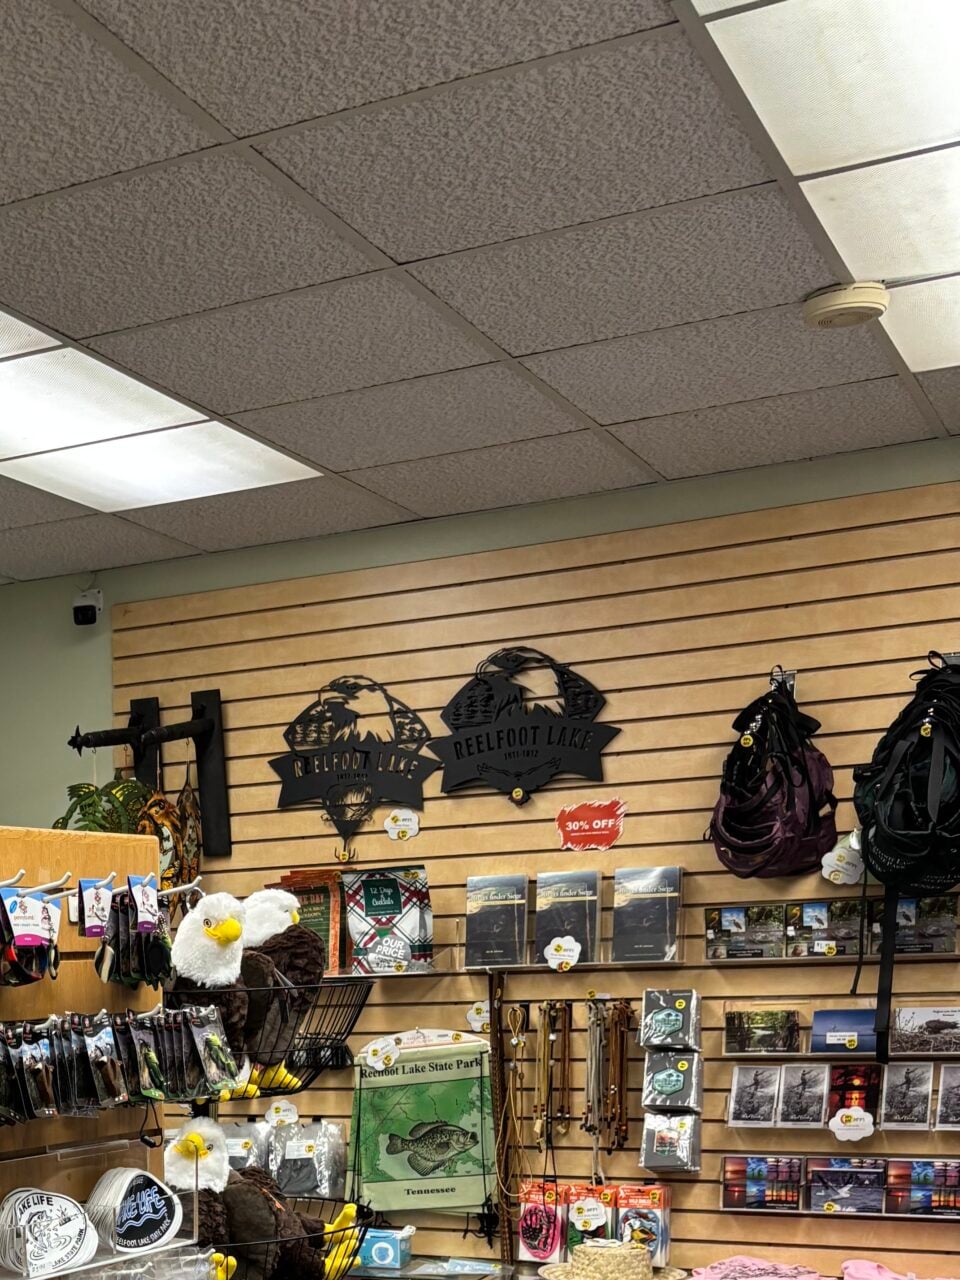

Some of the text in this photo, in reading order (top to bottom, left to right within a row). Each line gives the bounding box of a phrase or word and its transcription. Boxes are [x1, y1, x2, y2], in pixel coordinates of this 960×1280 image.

[453, 725, 594, 760] REELFOOT LAKE
[293, 750, 419, 779] REELFOOT LAKE
[565, 818, 615, 831] 30% OFF
[382, 937, 405, 949] OUR
[376, 945, 406, 959] PRICE
[401, 1063, 426, 1075] Lake
[428, 1061, 453, 1073] State
[456, 1057, 482, 1069] Park
[404, 1187, 456, 1196] Tennessee
[18, 1195, 54, 1216] AKE LIFE
[138, 1235, 151, 1246] LAKE
